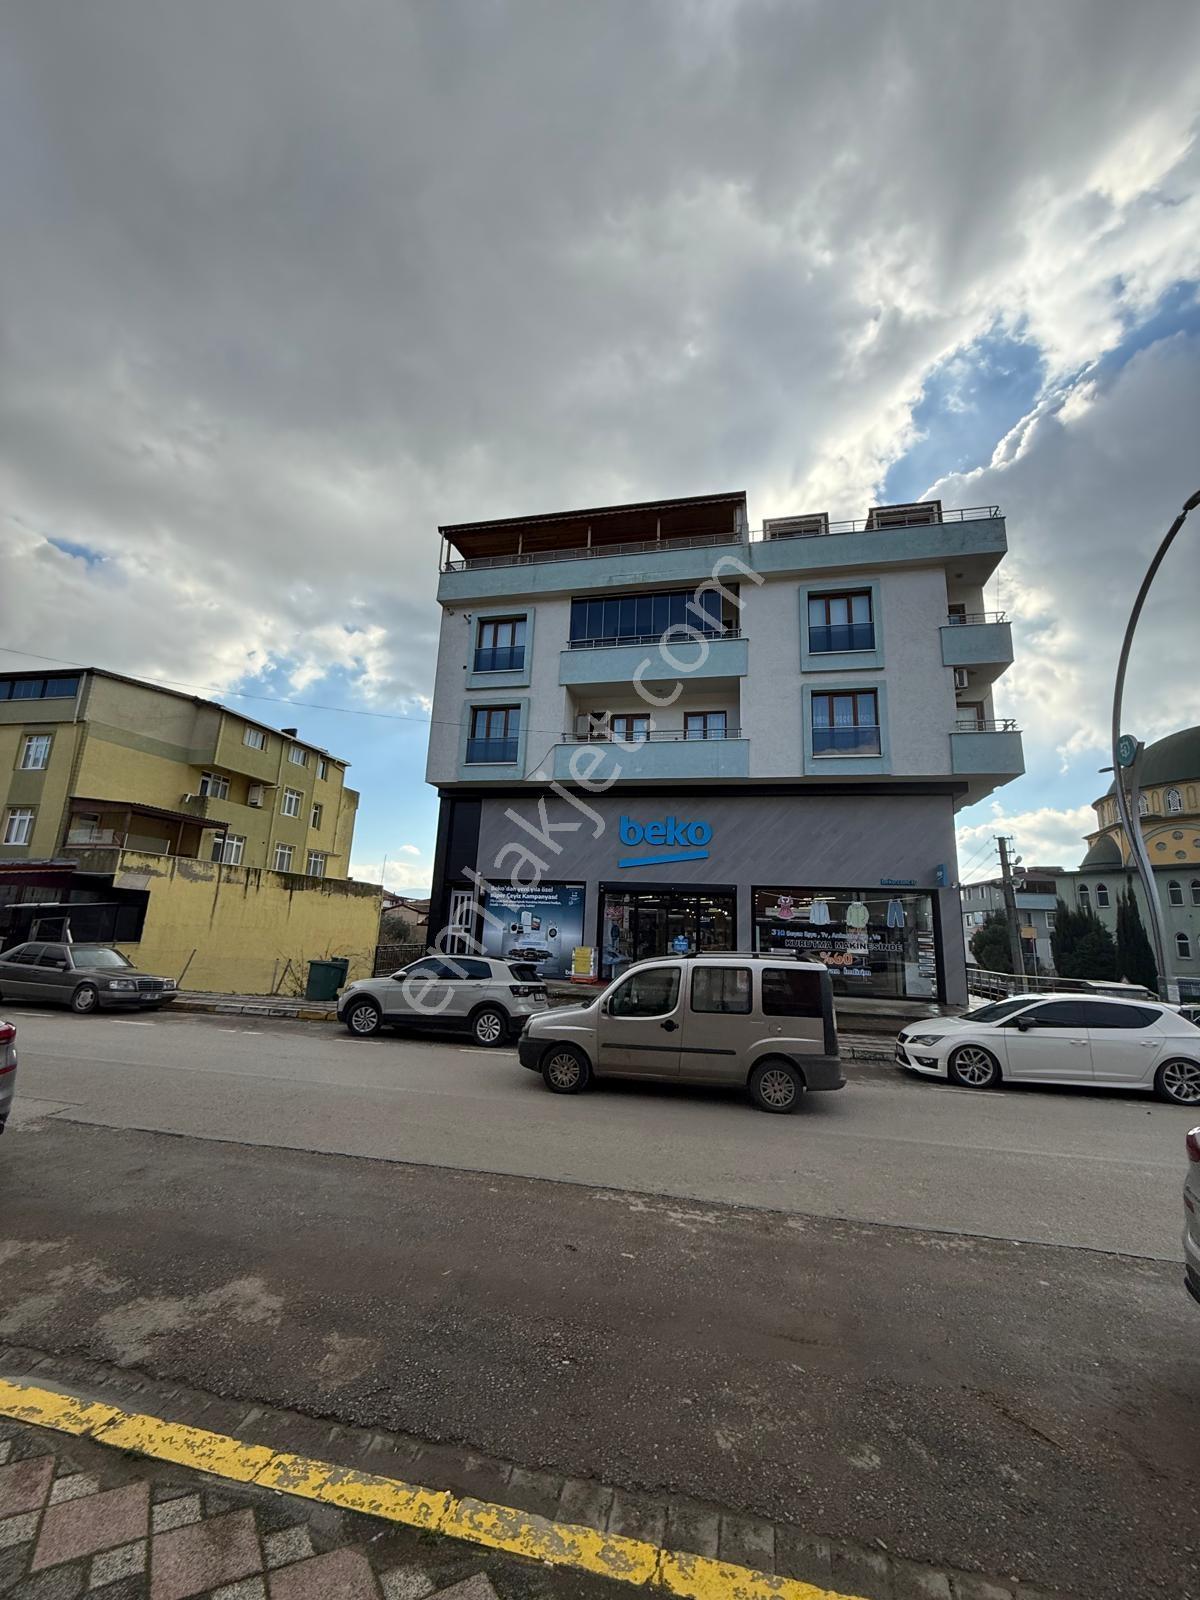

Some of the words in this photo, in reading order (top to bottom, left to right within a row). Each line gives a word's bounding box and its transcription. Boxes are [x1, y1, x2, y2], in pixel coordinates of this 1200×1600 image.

[619, 815, 713, 847] beko
[785, 939, 832, 949] KURUTMA
[820, 951, 853, 965] %60
